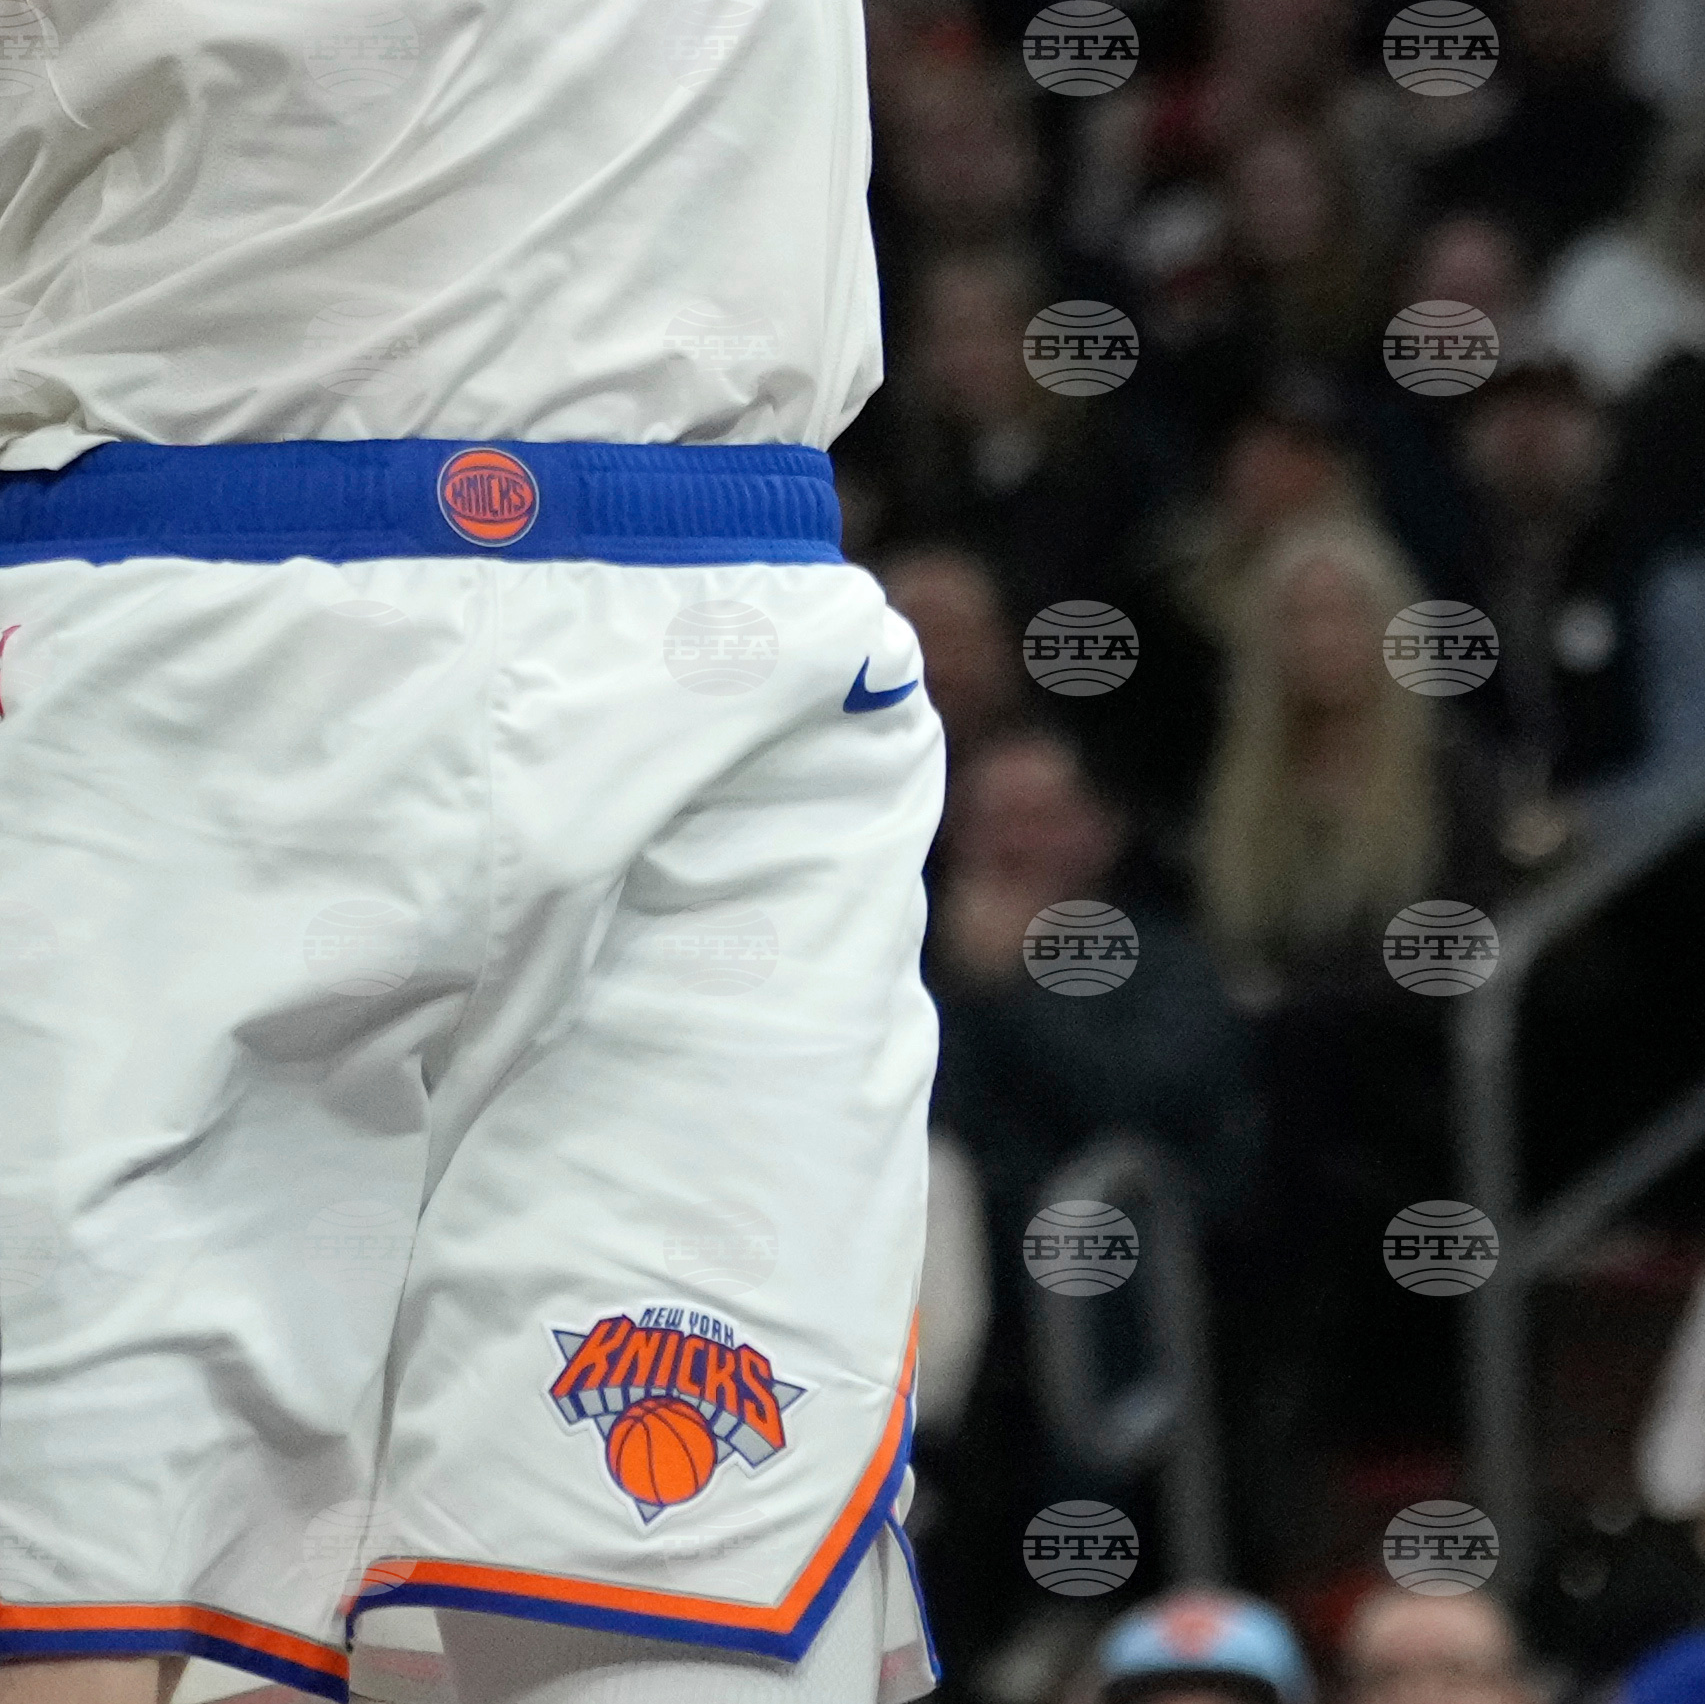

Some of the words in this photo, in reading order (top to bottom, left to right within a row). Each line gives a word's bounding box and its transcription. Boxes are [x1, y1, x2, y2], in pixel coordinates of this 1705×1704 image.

[452, 474, 526, 517] KNICKS
[639, 1306, 685, 1329] NEW
[689, 1310, 736, 1348] YORK
[549, 1314, 786, 1451] KNICKS
